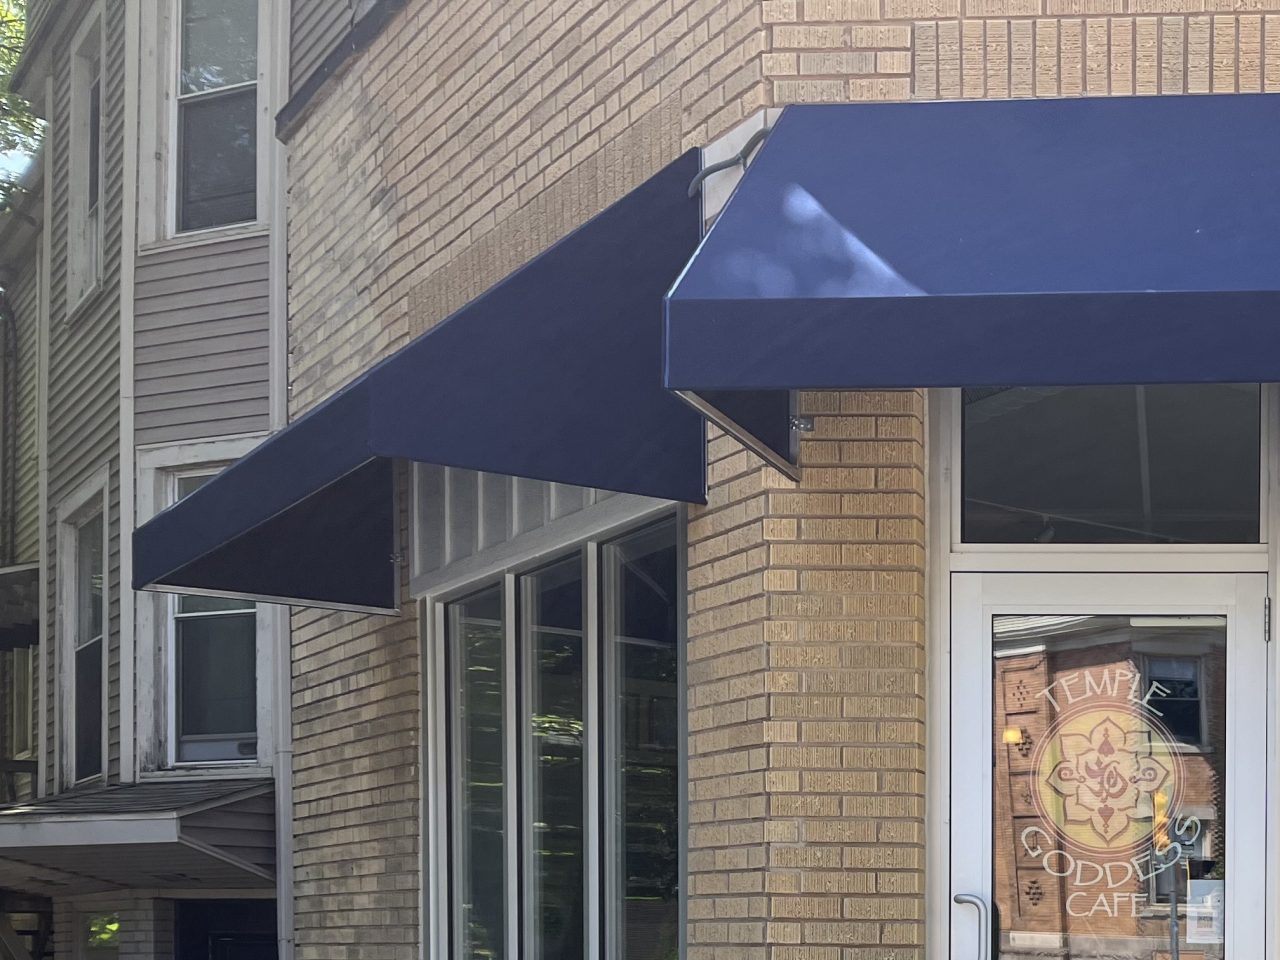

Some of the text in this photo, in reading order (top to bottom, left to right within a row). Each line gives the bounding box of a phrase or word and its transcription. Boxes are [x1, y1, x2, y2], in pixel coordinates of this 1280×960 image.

[1034, 668, 1172, 717] TEMPLE
[1020, 814, 1201, 889] GODDESS
[1065, 891, 1150, 918] CAFE
